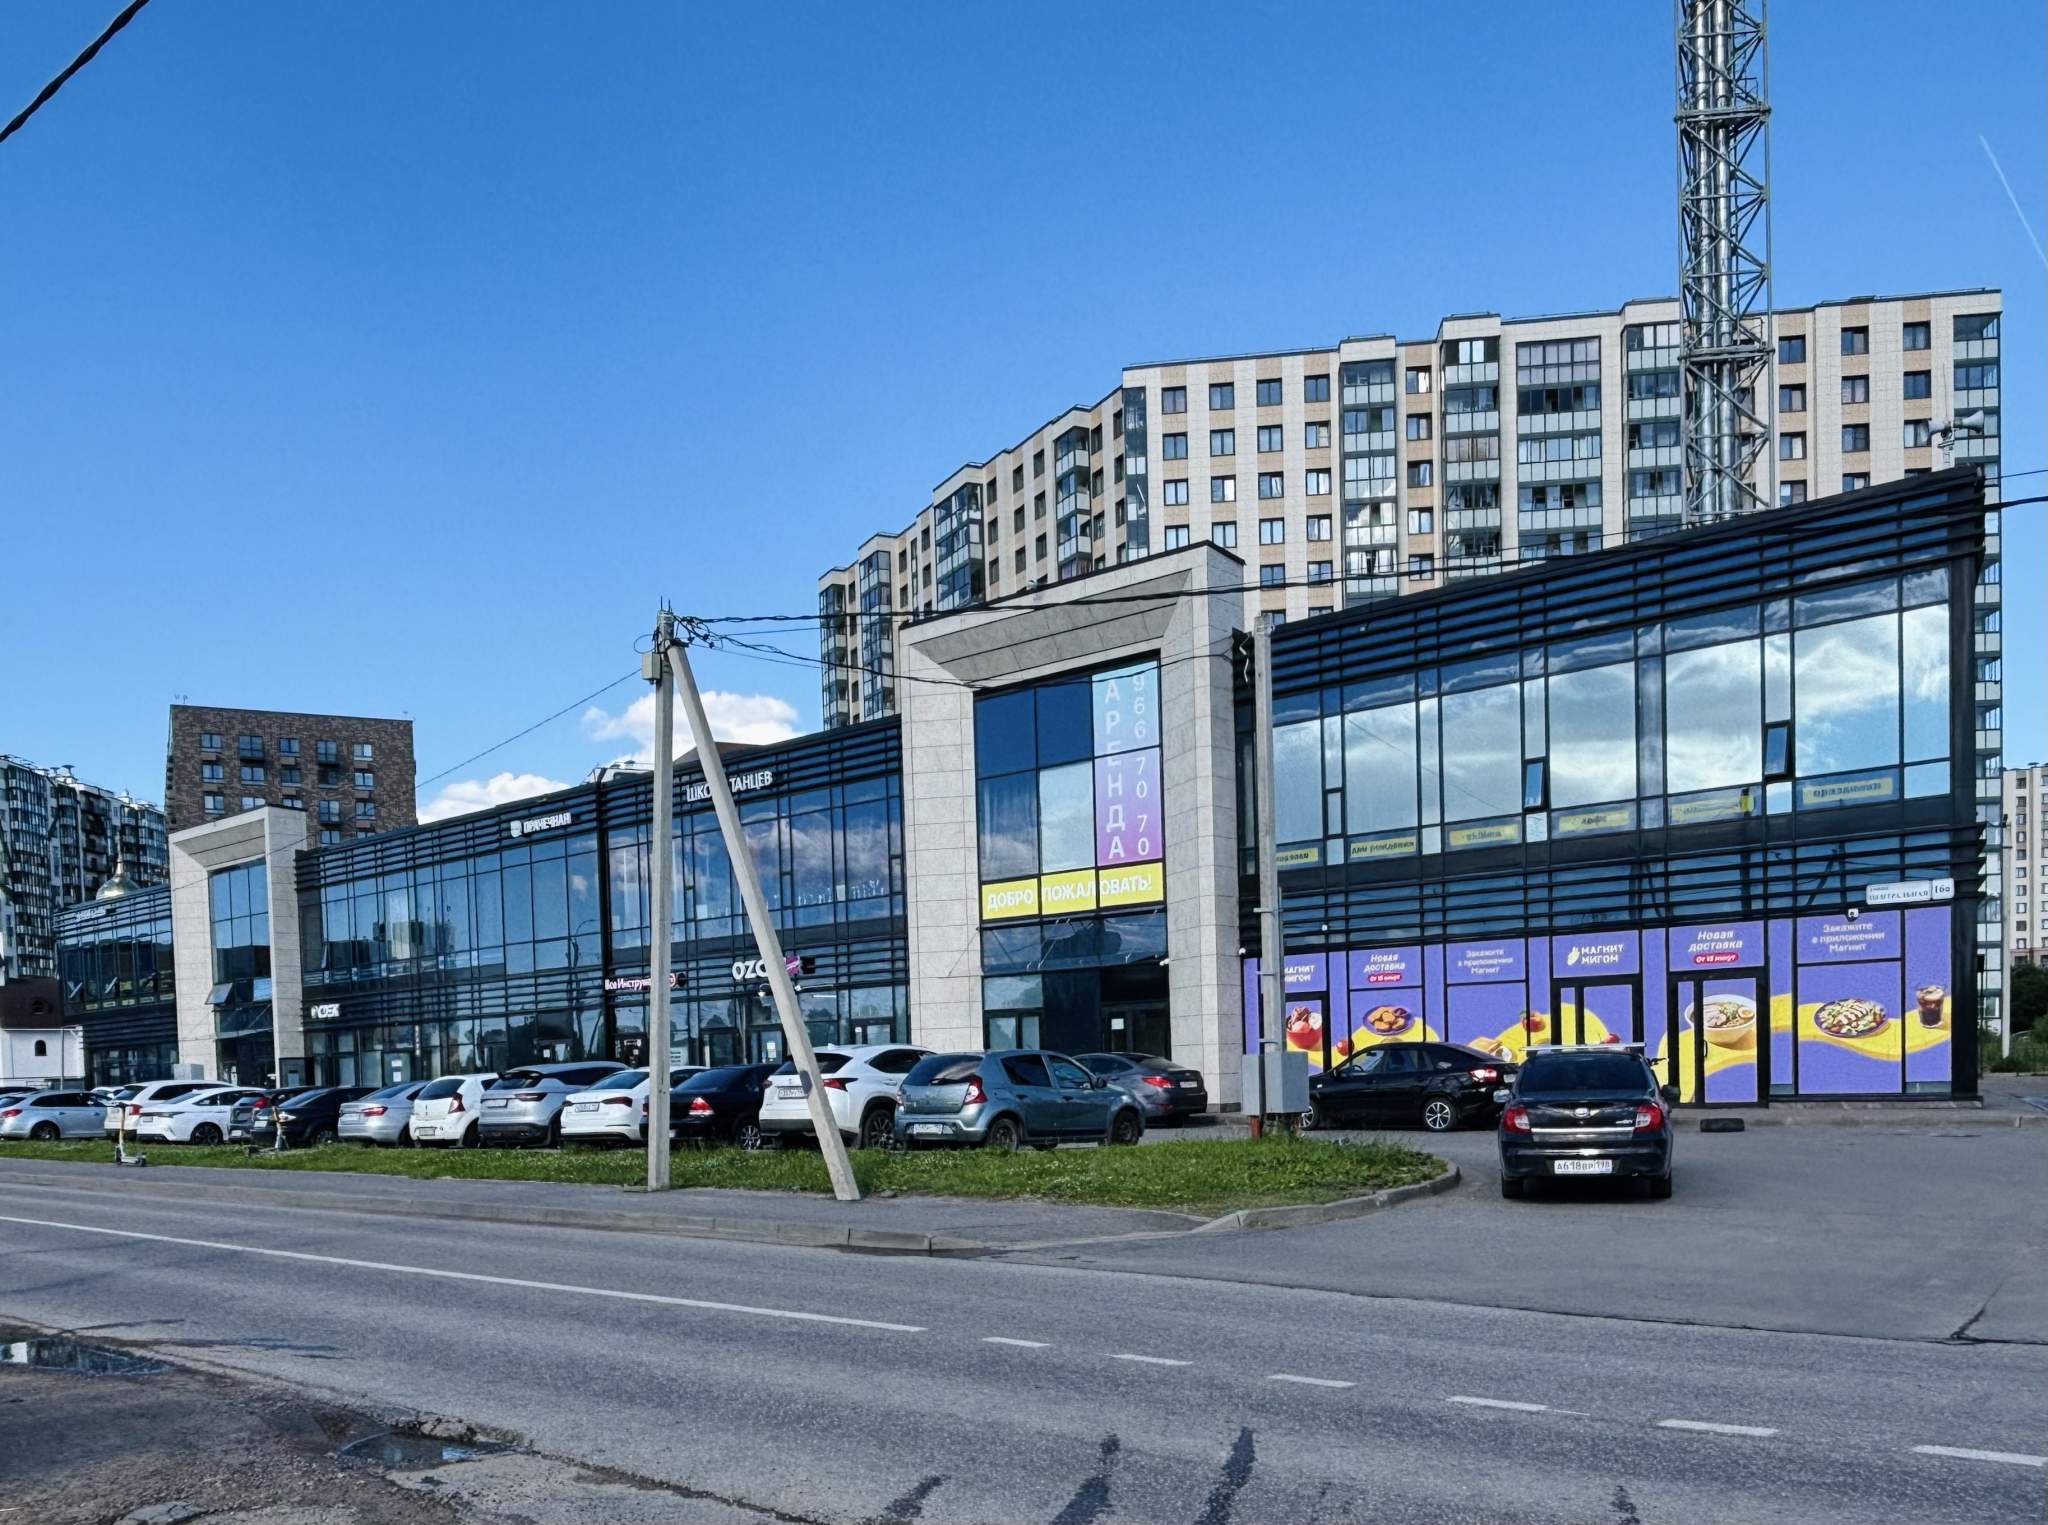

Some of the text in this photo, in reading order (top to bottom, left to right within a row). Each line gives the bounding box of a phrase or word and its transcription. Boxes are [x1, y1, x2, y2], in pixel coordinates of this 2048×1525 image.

[1104, 680, 1126, 859] АРЕНДА
[729, 770, 773, 793] ТАНЦЕВ
[523, 812, 572, 834] ПРАЧЕЧНАЯ
[988, 874, 1153, 912] ДОБРО ПОЖАЛОВАТЬ!
[1823, 923, 1873, 933] Закажите
[1697, 930, 1735, 941] Новая
[1581, 944, 1625, 955] МАГНИТ
[1688, 940, 1744, 952] доставка
[1829, 943, 1867, 953] Магнит
[1370, 954, 1399, 963] Новая
[1581, 954, 1619, 965] МИГОМ
[732, 959, 769, 981] OZO
[1363, 962, 1406, 973] доставка
